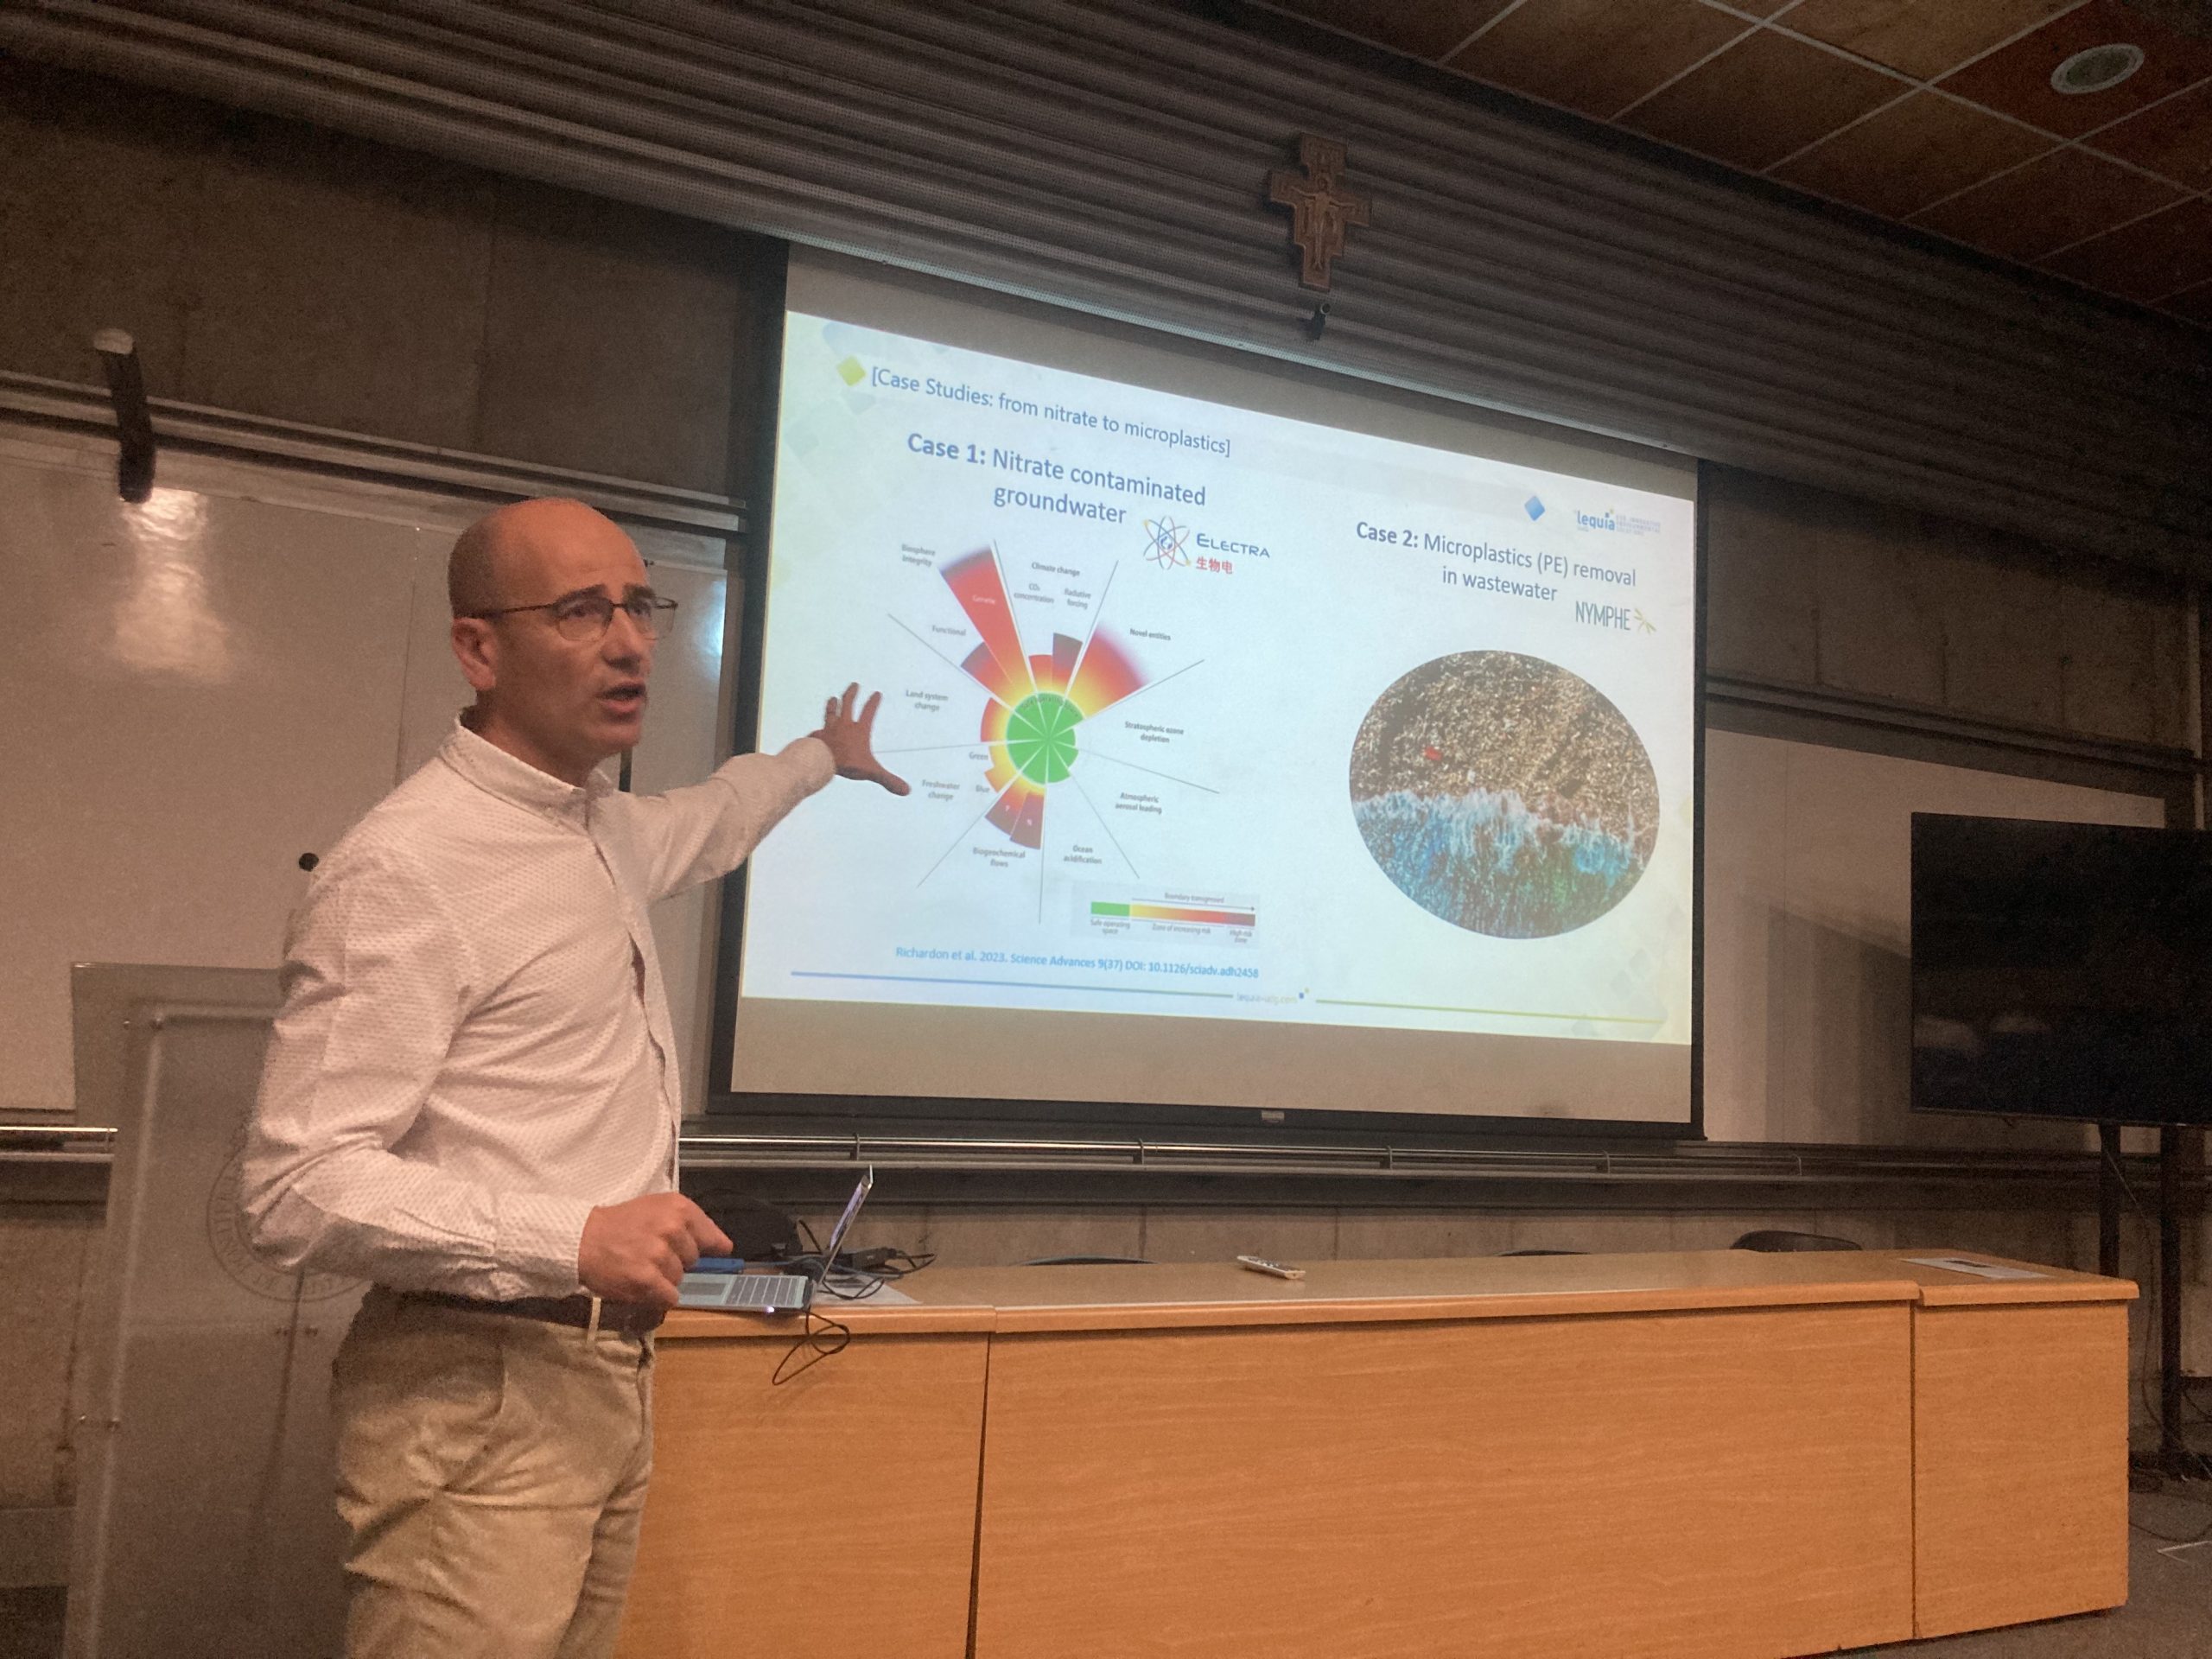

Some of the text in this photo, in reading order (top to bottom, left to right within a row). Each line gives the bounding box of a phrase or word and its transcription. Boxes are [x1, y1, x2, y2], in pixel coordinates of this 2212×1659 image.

[871, 366, 1231, 458] [Case Studies: from nitrate to microplastics]
[907, 432, 1206, 507] Case 1: Nitrate contaminated
[993, 486, 1128, 524] groundwater
[1357, 521, 1637, 587] Case 2: Microplastics (PE) removal
[1032, 562, 1080, 577] Climate change
[1195, 556, 1234, 575] 生物电
[1442, 566, 1558, 602] in wastewater
[1575, 601, 1631, 632] NYMPHE
[932, 624, 967, 636] Functional
[1130, 628, 1147, 638] Novel
[906, 690, 949, 702] Land system
[914, 702, 940, 712] change
[1125, 721, 1185, 735] Stratospheric ozone
[1140, 734, 1170, 744] depletion
[969, 752, 988, 761] Green
[1120, 792, 1159, 804] Atmospheric
[1116, 802, 1162, 816] aerosol loading
[1072, 844, 1093, 854] Ocean
[896, 946, 949, 960] Richardon
[951, 950, 962, 961] et
[964, 950, 976, 962] al.
[980, 952, 1008, 963] 2023.
[1010, 953, 1048, 966] Science
[1049, 956, 1096, 969] Advances
[1098, 959, 1123, 972] 9(37)
[1125, 960, 1147, 971] DOI:
